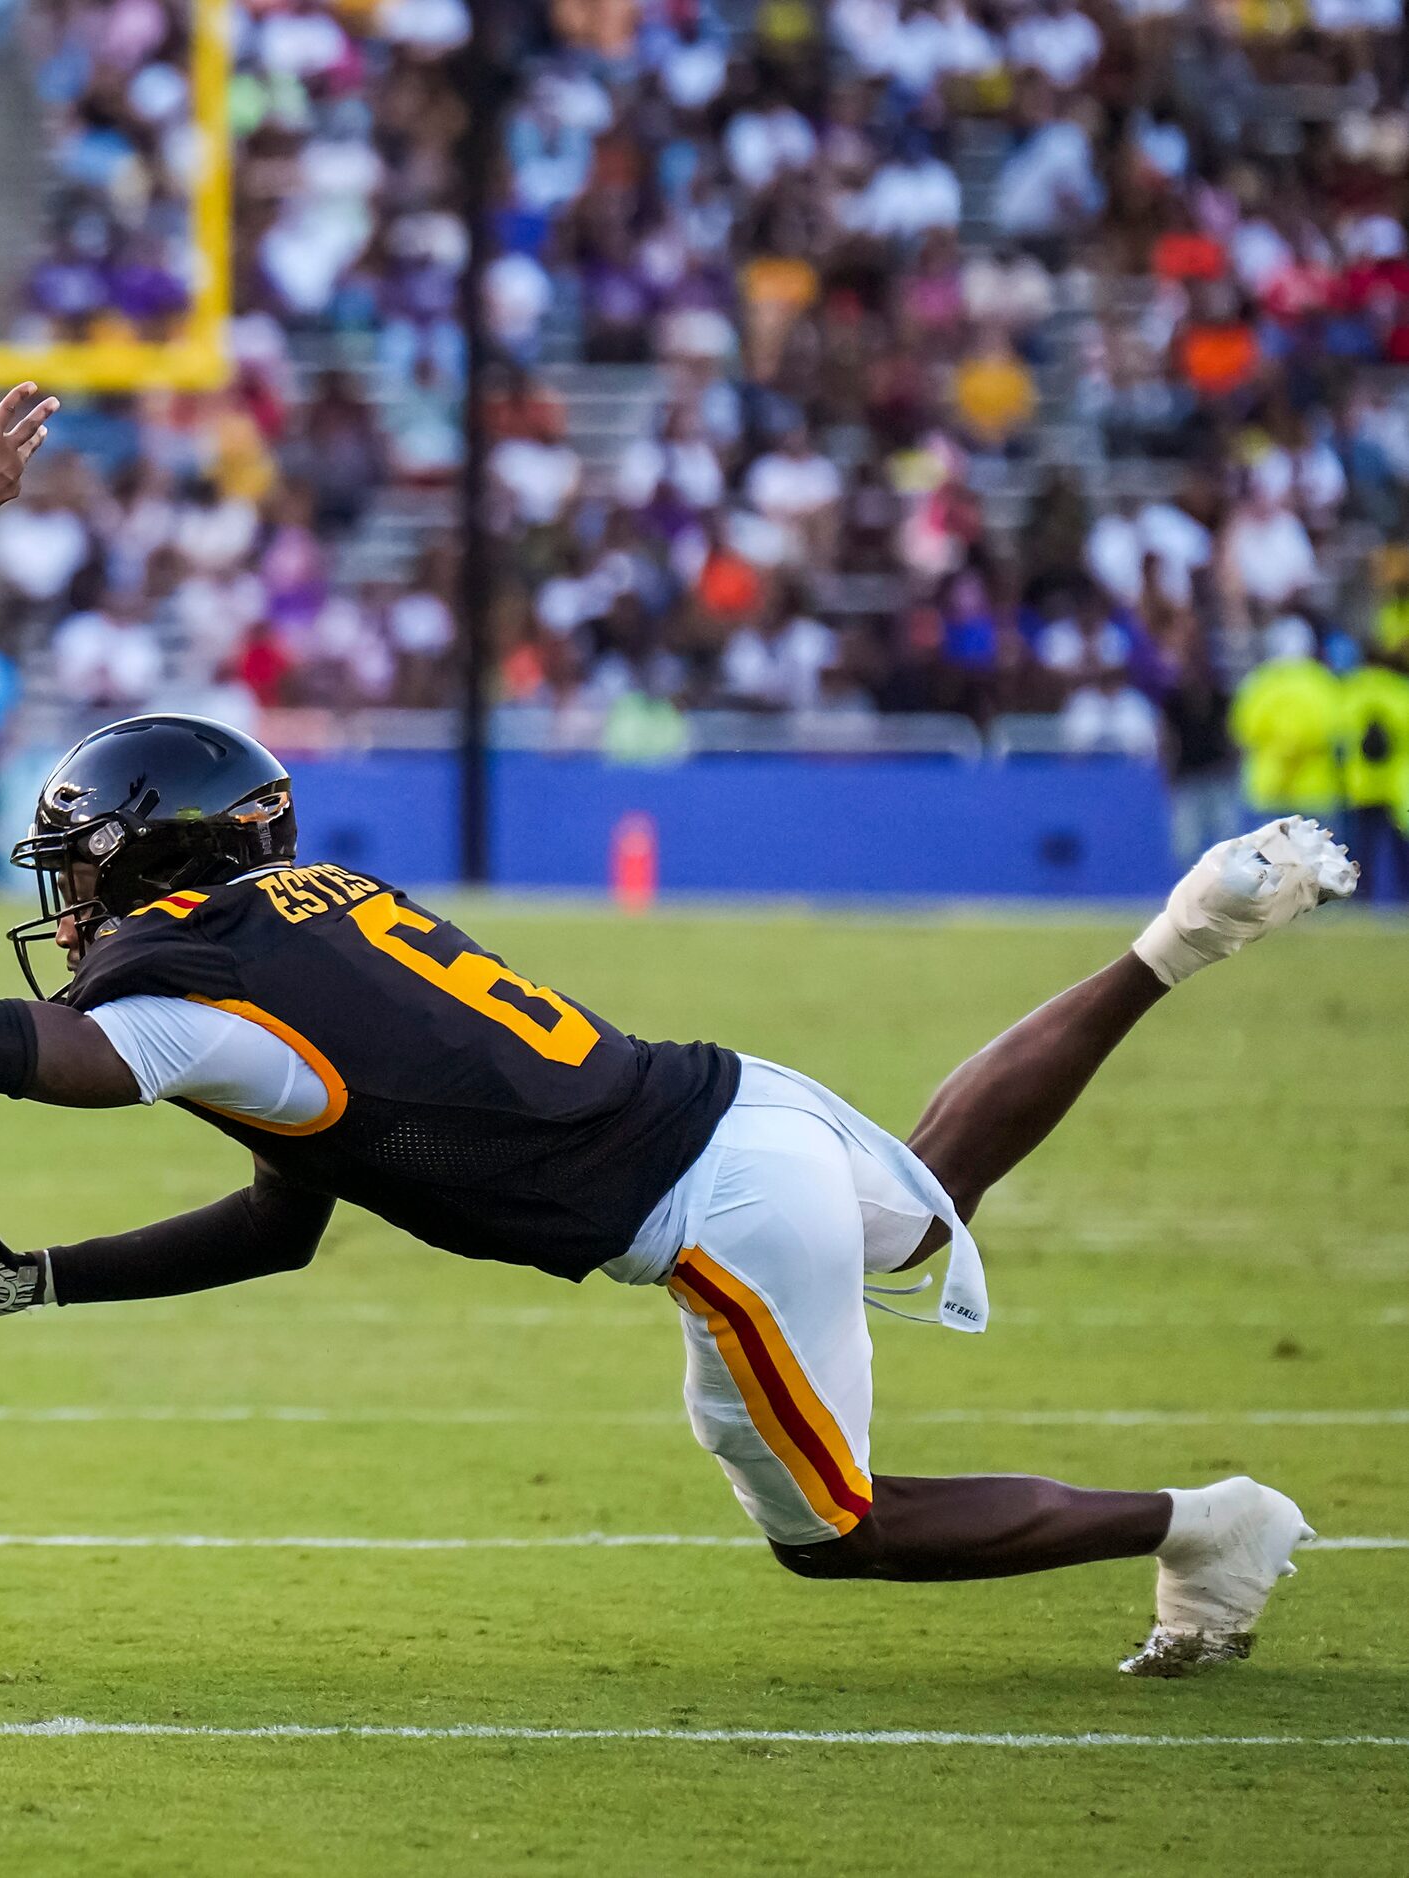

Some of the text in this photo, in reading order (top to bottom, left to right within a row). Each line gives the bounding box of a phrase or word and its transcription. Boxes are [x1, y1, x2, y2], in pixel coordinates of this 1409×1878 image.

[255, 862, 380, 924] ESTES
[347, 892, 602, 1067] 6
[944, 1301, 979, 1321] WE BALL
